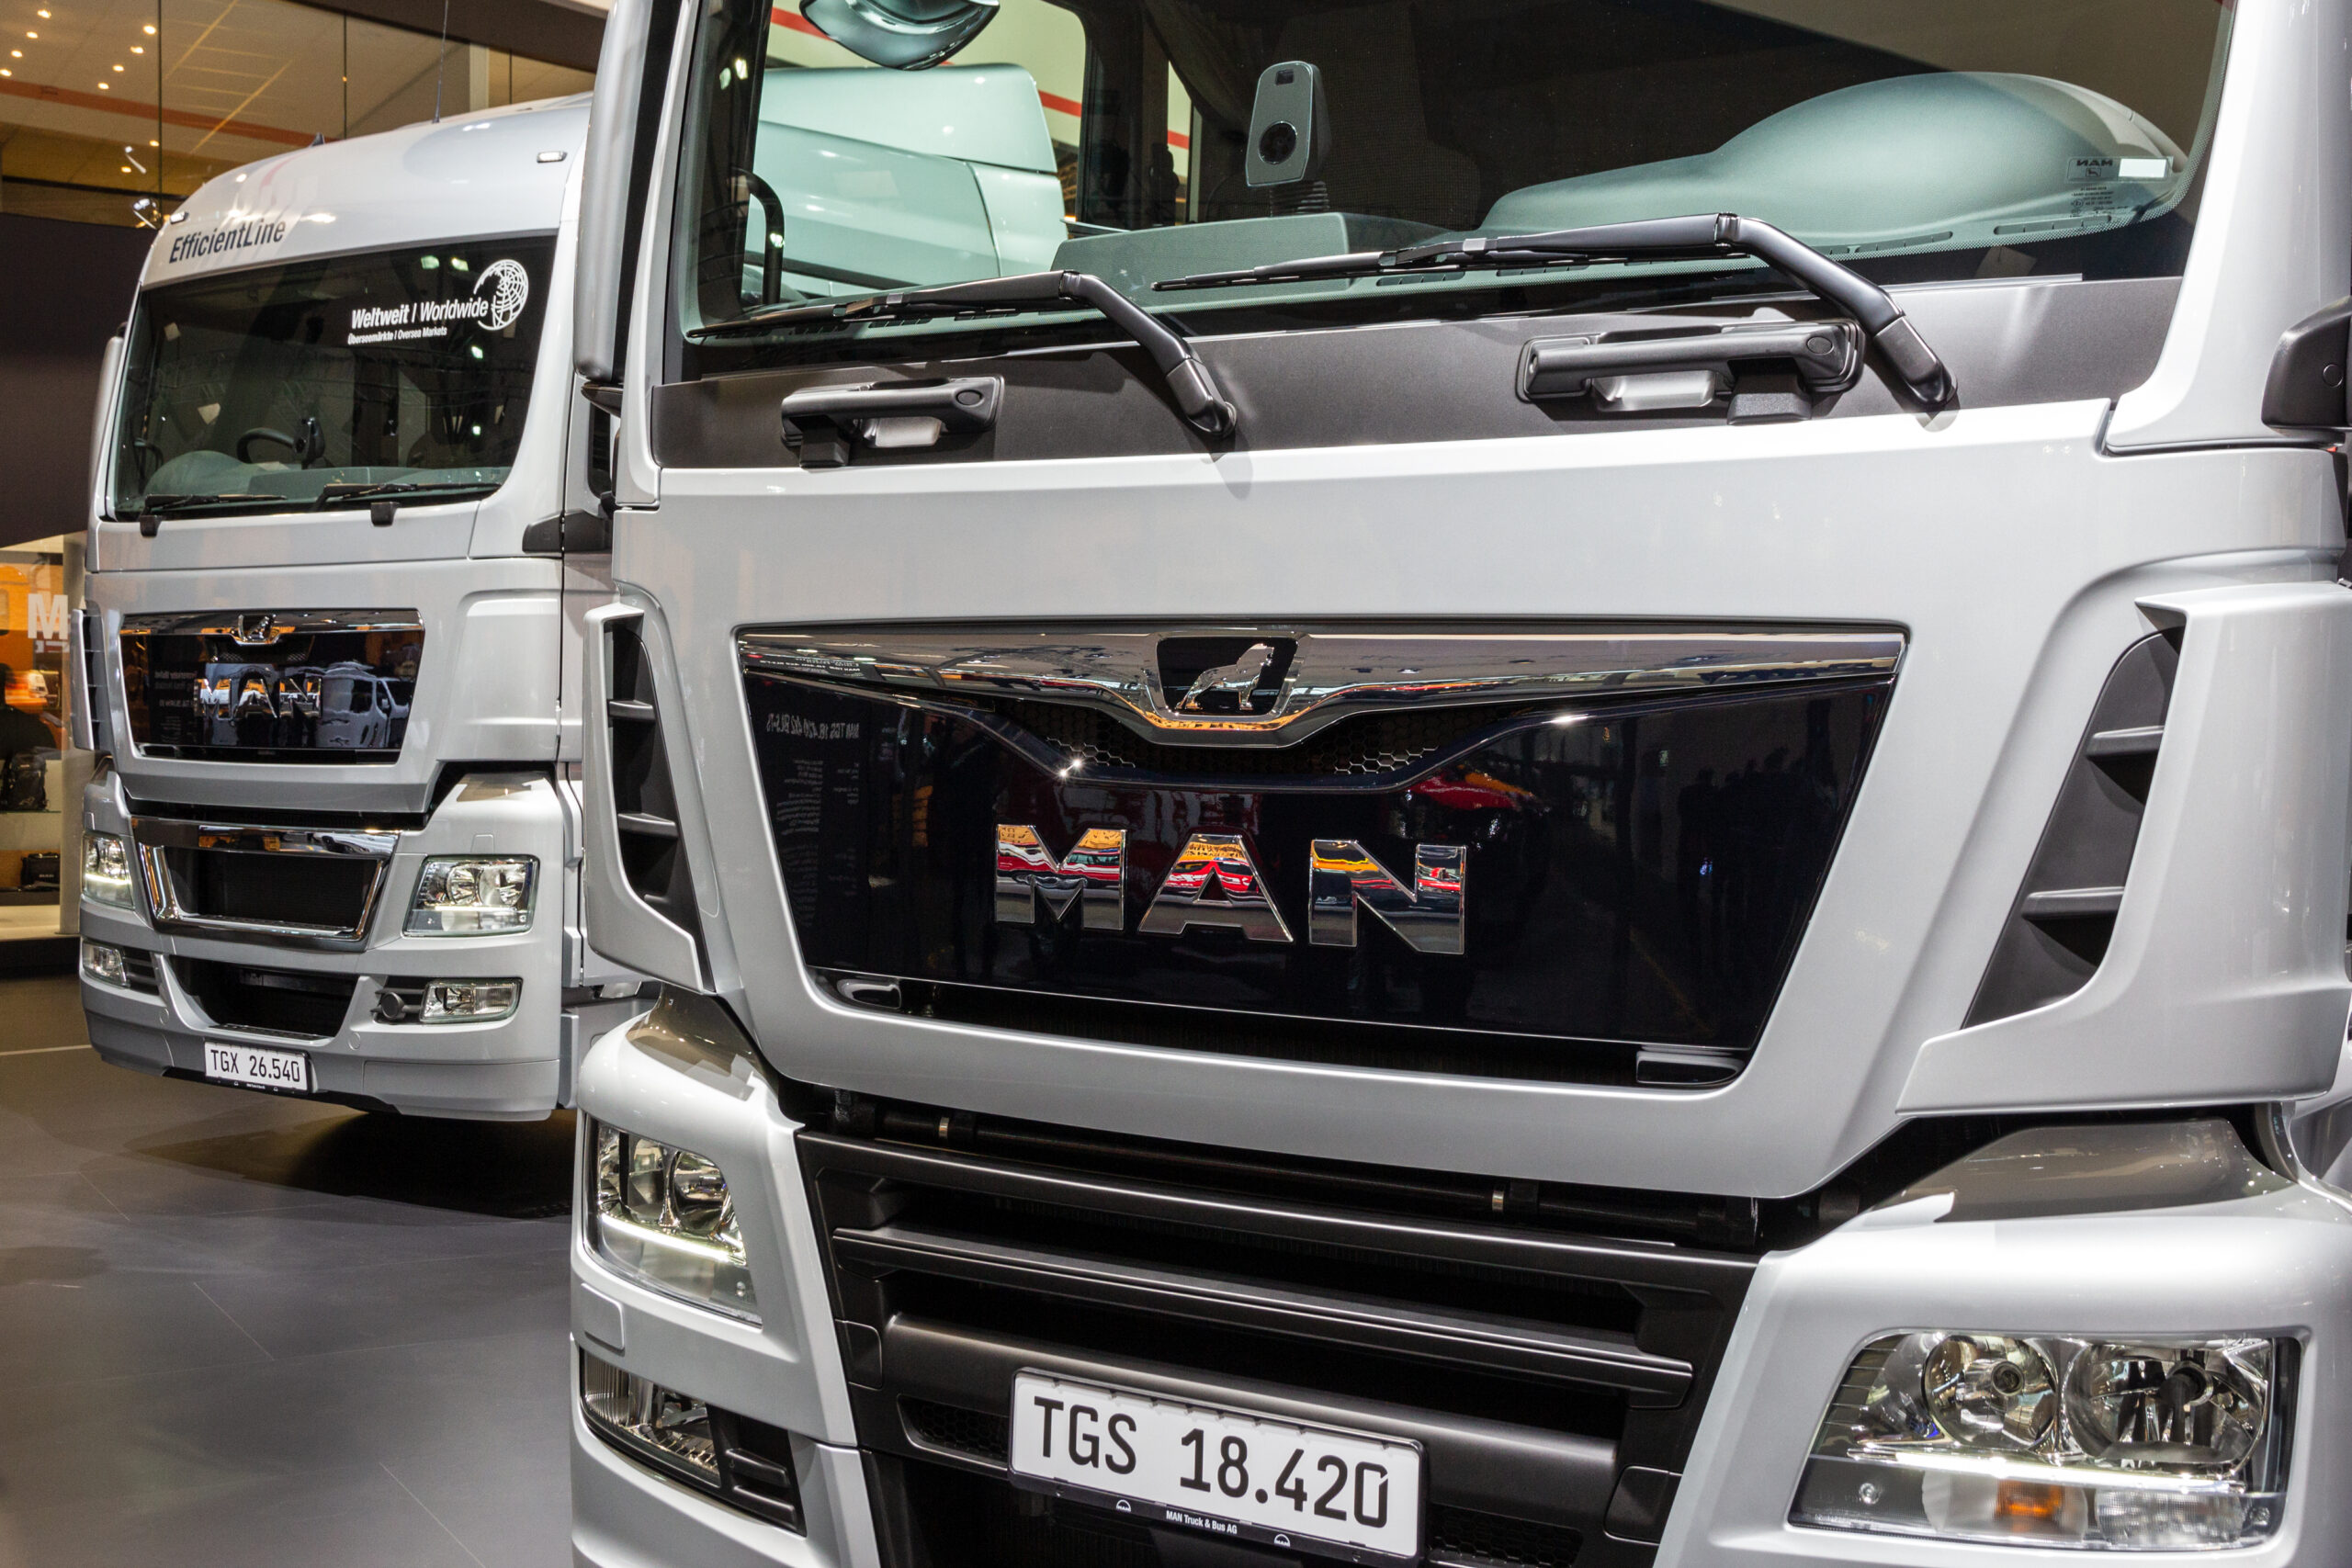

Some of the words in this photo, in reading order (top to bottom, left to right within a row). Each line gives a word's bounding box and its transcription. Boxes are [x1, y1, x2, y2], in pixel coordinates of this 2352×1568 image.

[169, 218, 287, 265] EfficientLine
[351, 304, 410, 330] Weltweit
[420, 296, 489, 322] Worldwide
[398, 328, 422, 340] Oversea
[422, 325, 447, 337] Markets
[194, 677, 322, 720] MAN
[995, 824, 1467, 954] MAN
[210, 1049, 239, 1074] TGX
[249, 1055, 300, 1083] 26.540
[1034, 1395, 1137, 1475] TGS
[1180, 1427, 1388, 1529] 18.420
[1166, 1510, 1182, 1523] MAN
[1183, 1514, 1204, 1528] Truck
[1204, 1518, 1211, 1529] &
[1212, 1520, 1226, 1532] Bus
[1227, 1523, 1238, 1535] AG
